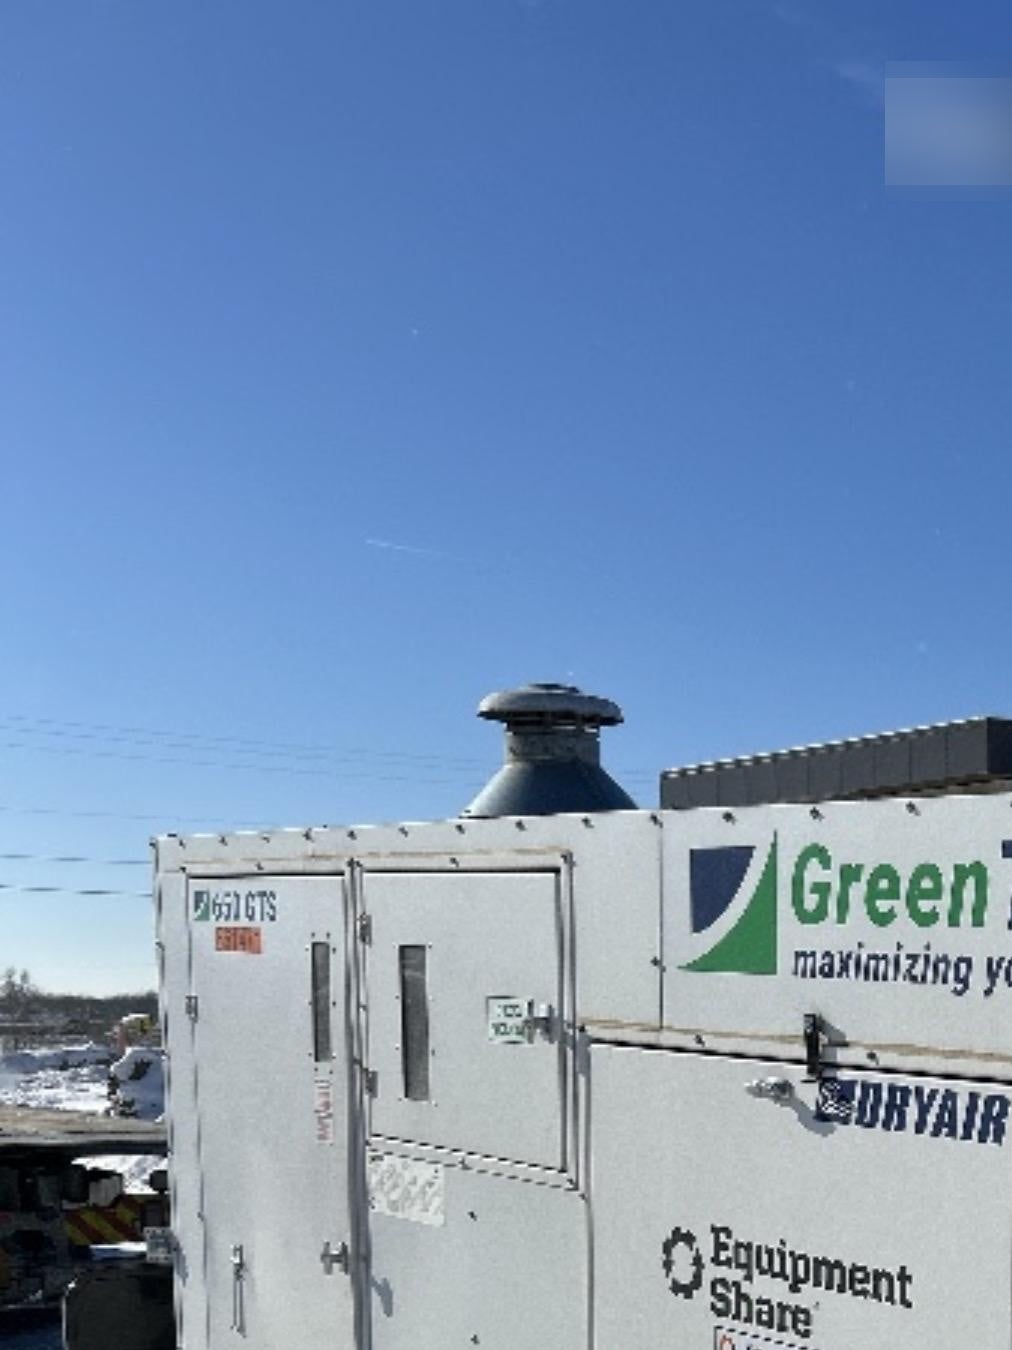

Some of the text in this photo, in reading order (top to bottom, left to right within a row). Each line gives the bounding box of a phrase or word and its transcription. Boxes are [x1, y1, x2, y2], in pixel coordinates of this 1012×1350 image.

[245, 889, 277, 922] GTS
[792, 942, 973, 996] maximizing
[854, 1080, 1011, 1146] DRYAIR
[710, 1223, 913, 1309] Equipment
[710, 1277, 812, 1338] Share
